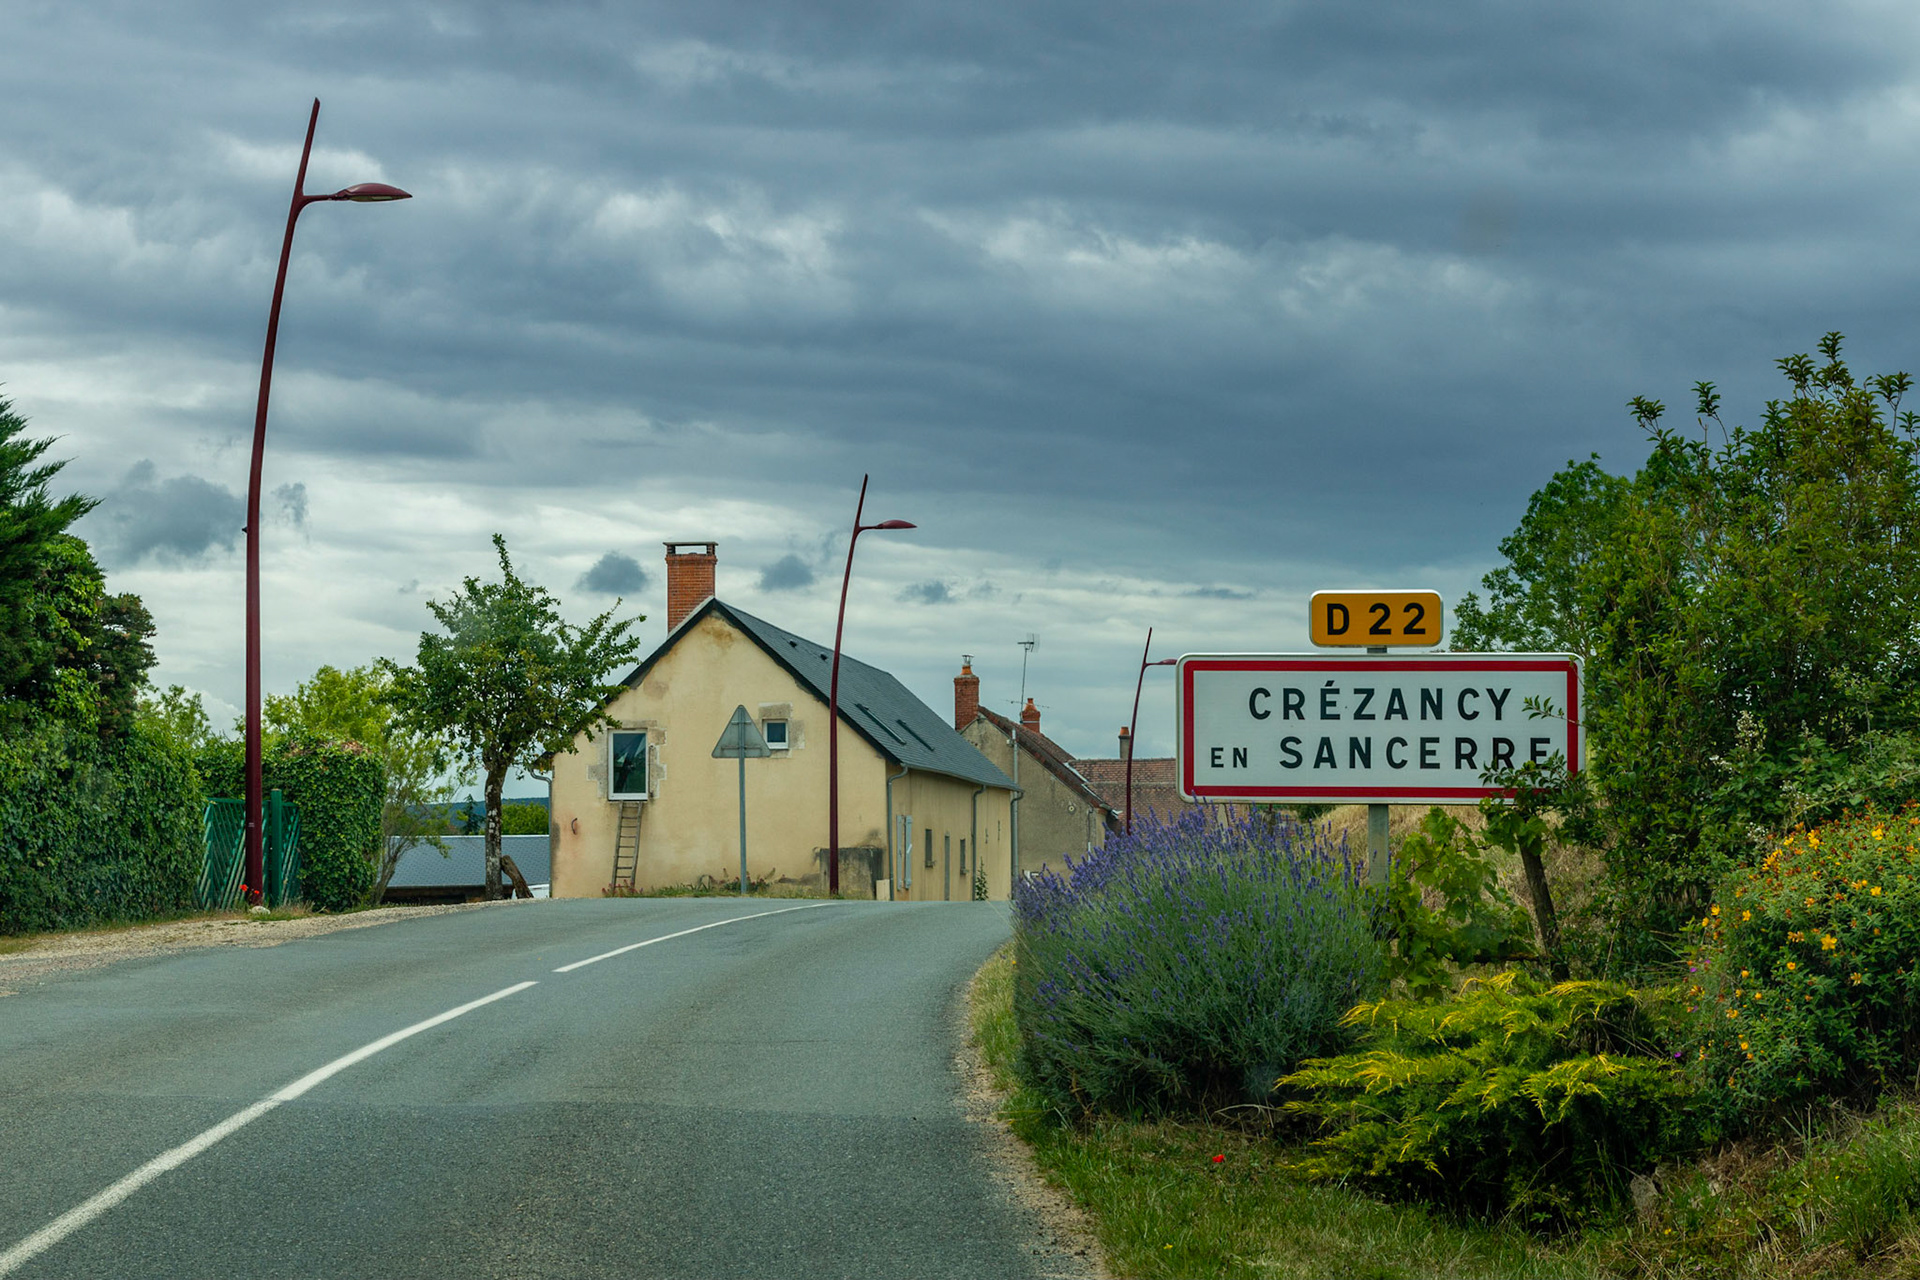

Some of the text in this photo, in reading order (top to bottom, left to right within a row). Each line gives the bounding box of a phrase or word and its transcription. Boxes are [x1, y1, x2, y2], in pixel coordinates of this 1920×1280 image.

[1326, 602, 1427, 636] D 22
[1248, 680, 1512, 721] CRÉZANCY
[1210, 736, 1551, 770] EN SANCERRE
